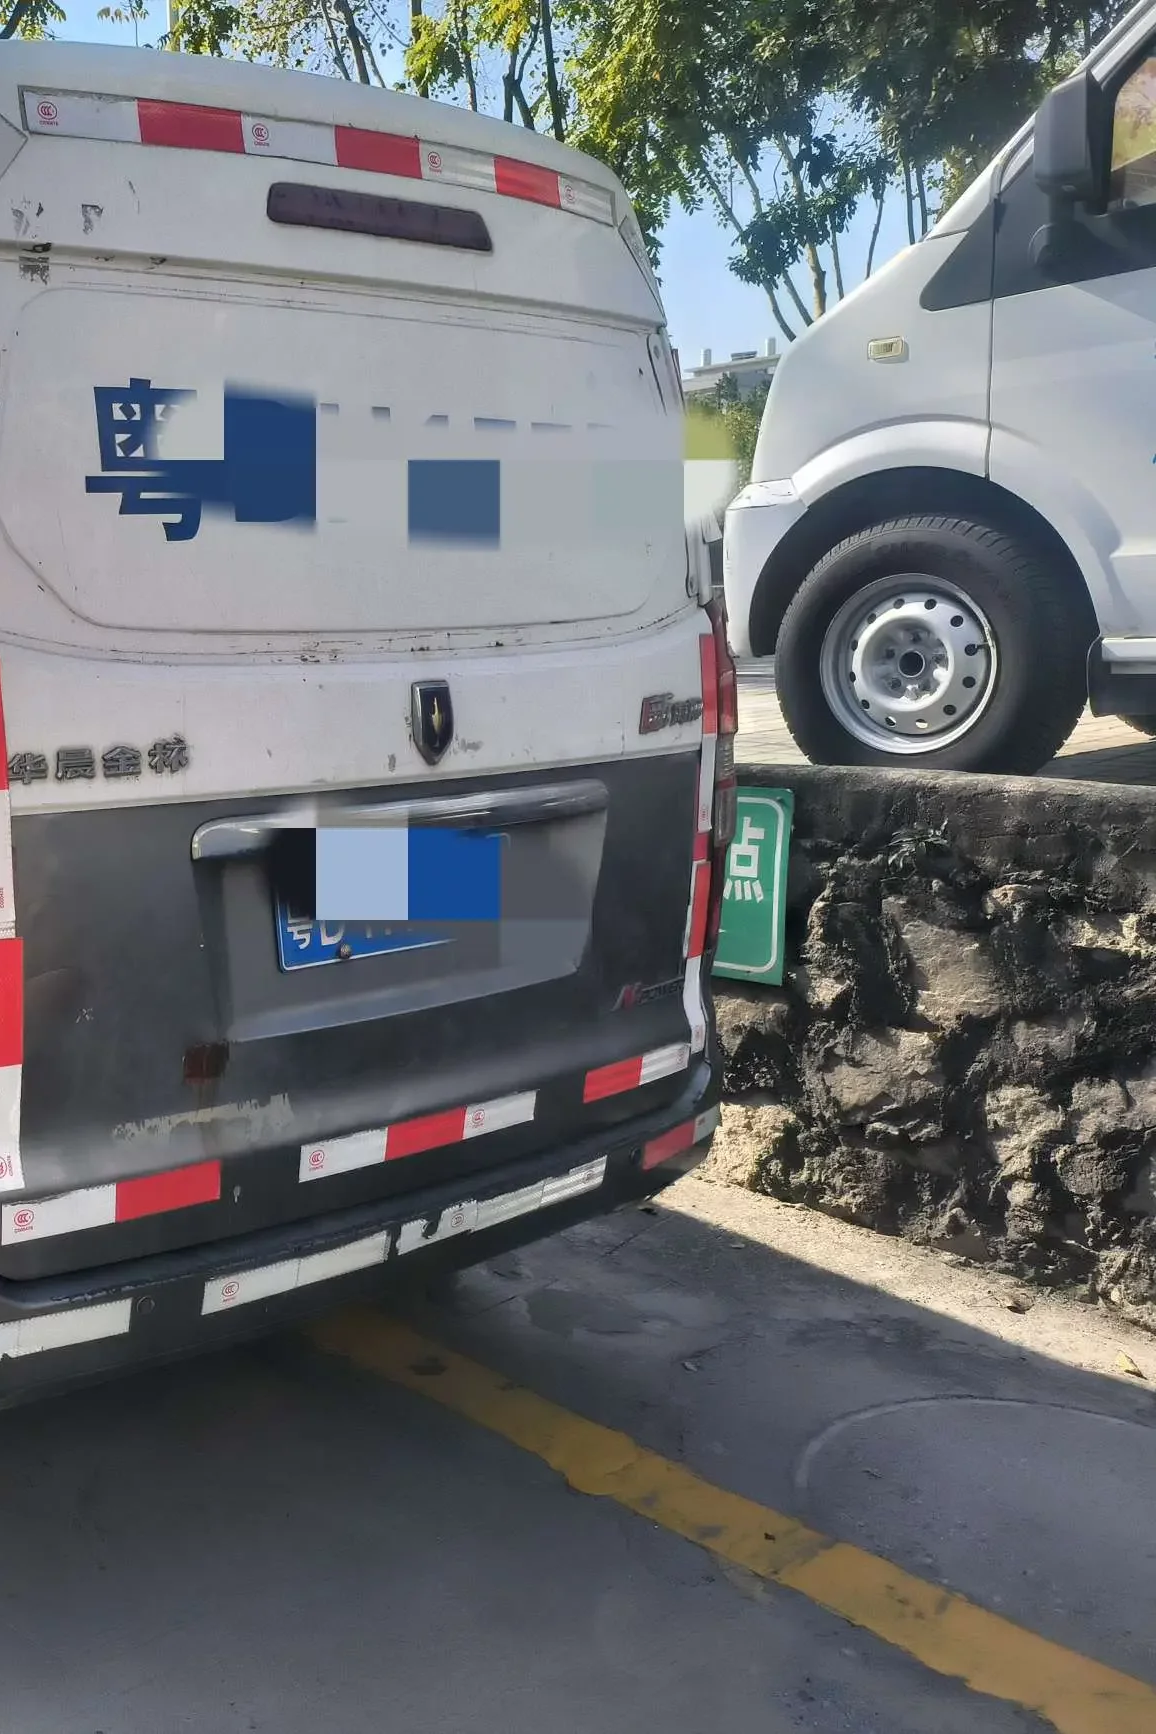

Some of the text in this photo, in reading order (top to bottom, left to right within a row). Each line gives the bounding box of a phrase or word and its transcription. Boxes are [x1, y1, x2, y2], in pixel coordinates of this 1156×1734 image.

[7, 736, 190, 785] 华晨金杯
[723, 816, 765, 904] 点
